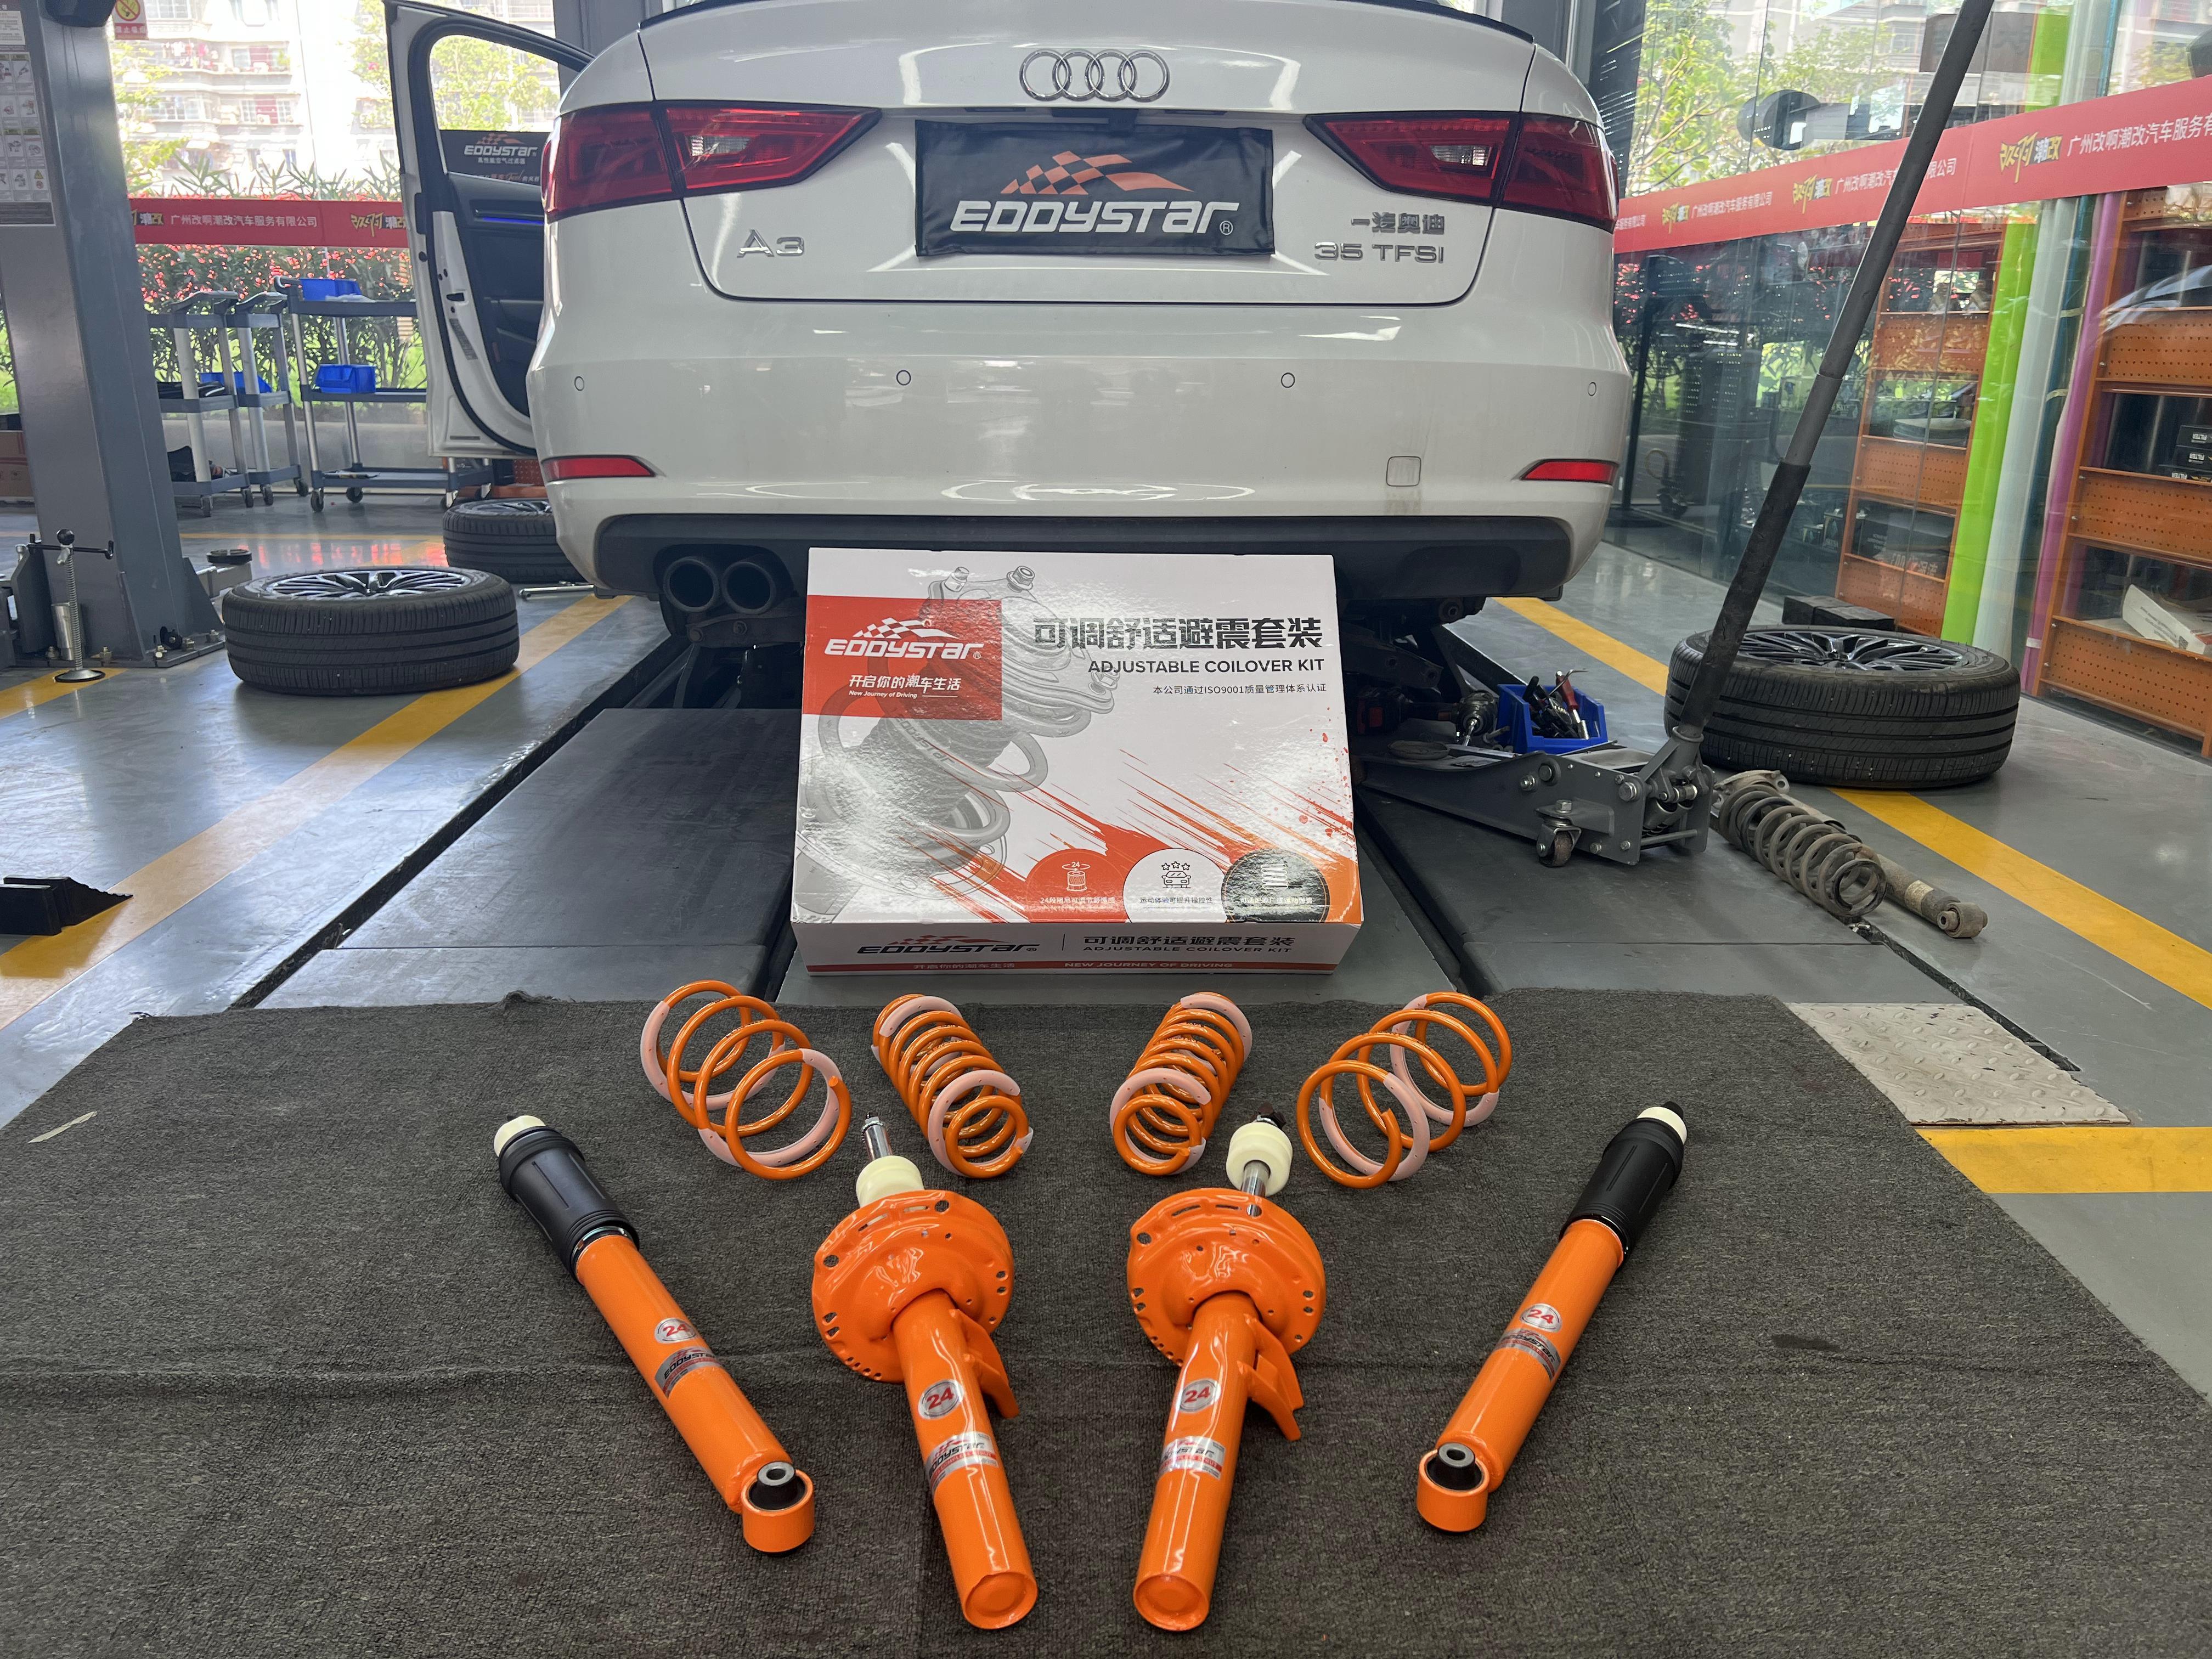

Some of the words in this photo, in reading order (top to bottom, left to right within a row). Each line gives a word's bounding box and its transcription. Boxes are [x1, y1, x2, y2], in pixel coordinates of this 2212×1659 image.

[737, 229, 805, 258] A3
[1314, 241, 1363, 261] 35
[1372, 244, 1444, 263] TFSI
[1032, 617, 1323, 650] 可调舒适避震套装
[1088, 660, 1199, 674] ADJUSTABLE
[1205, 660, 1293, 673] COILOVER
[1298, 659, 1324, 672] KIT
[849, 673, 962, 694] 开启你的潮车生活
[1153, 683, 1327, 696] 本公司通过ISO9001质量管理体系认证
[1083, 936, 1296, 946] 可调舒适避震套装
[1527, 1309, 1554, 1324] 24
[662, 1324, 690, 1338] 24
[926, 1387, 955, 1410] 24
[1184, 1386, 1211, 1403] 24
